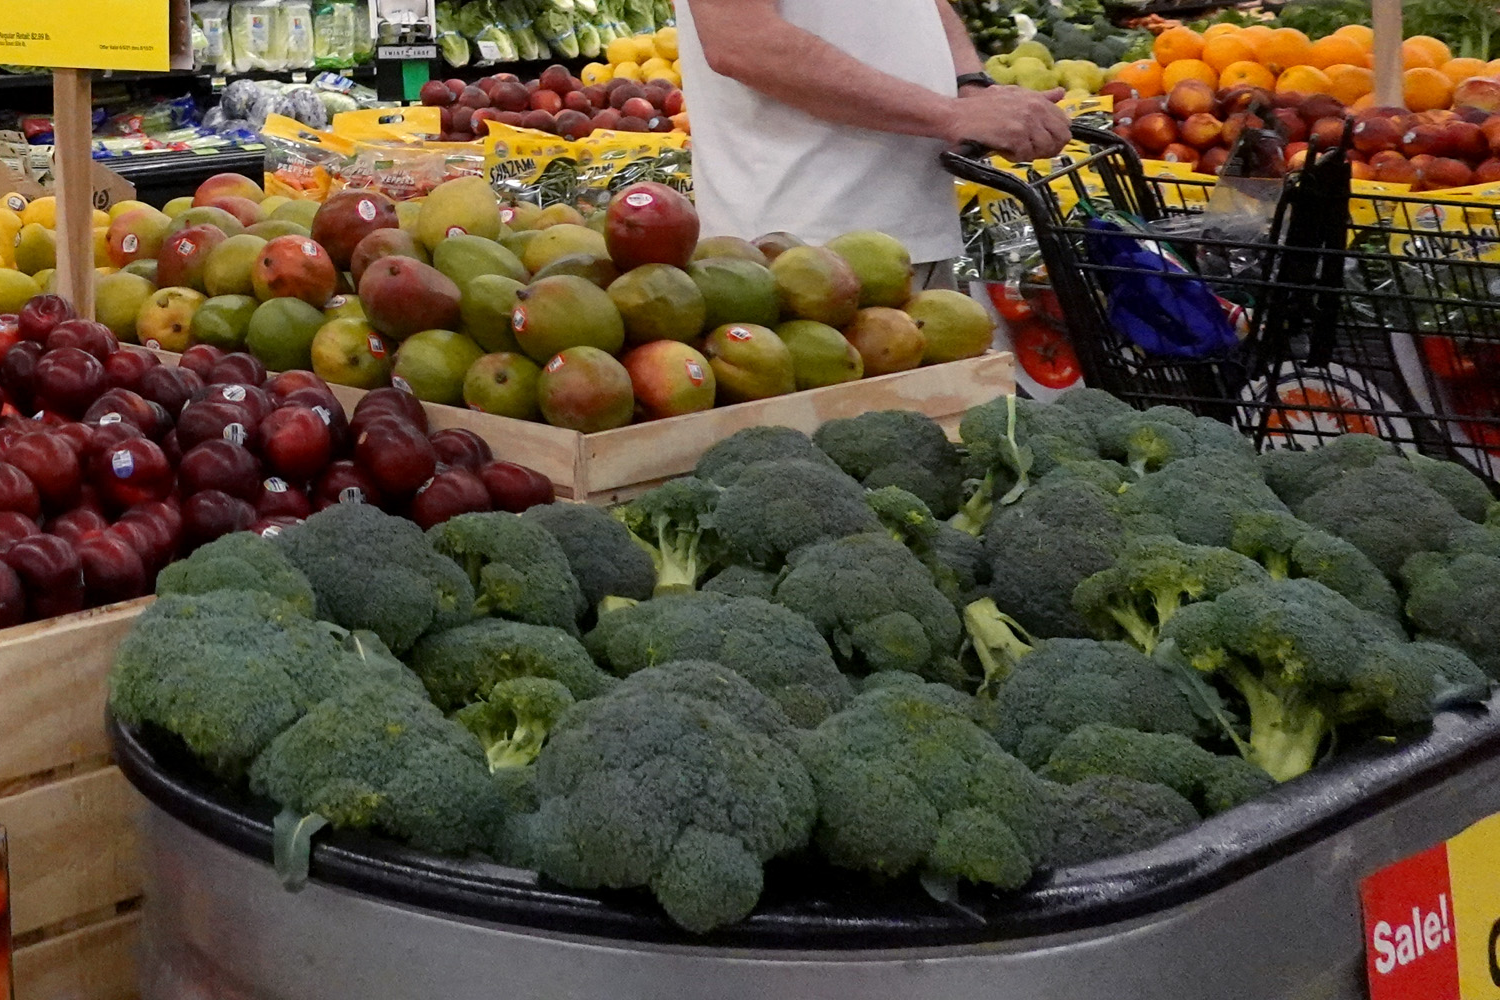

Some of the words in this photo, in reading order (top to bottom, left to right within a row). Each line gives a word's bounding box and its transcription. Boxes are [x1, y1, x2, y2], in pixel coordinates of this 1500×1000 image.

[277, 162, 315, 177] PEPPERS
[489, 157, 536, 185] SHAZAM!
[1373, 892, 1451, 975] Sale!
